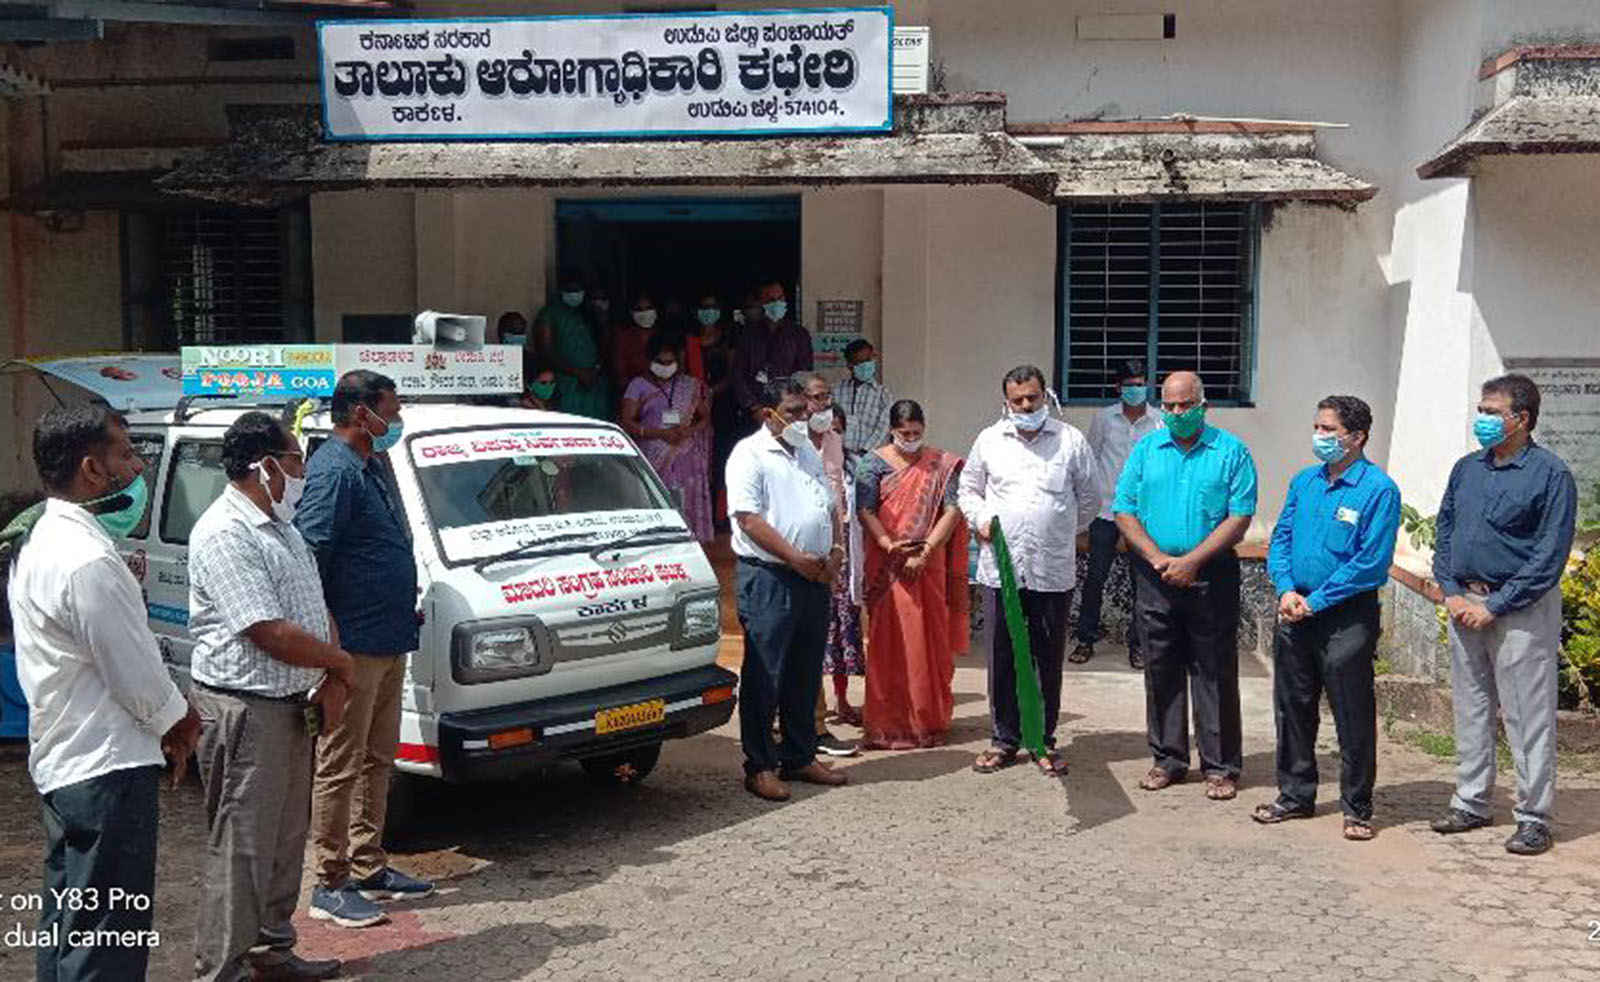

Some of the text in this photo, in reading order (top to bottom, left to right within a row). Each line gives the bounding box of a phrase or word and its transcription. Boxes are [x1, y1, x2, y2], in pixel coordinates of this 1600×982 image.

[359, 28, 491, 50] ಕರ್ನಾಟಕ ಸರಕಾರ
[664, 19, 855, 47] ಉಡುಪಿ ಜಿಲ್ಲಾ ಪಂಚಾಯತ್
[334, 44, 855, 104] ತಾಲೂಕು ಆರೋಗ್ಯಾಧಿಕಾರಿ ಕಛೇರಿ
[392, 103, 463, 123] ಕಾರ್ಕಳ.
[688, 101, 747, 118] ಉಡುಪಿ
[200, 346, 286, 367] NOORI
